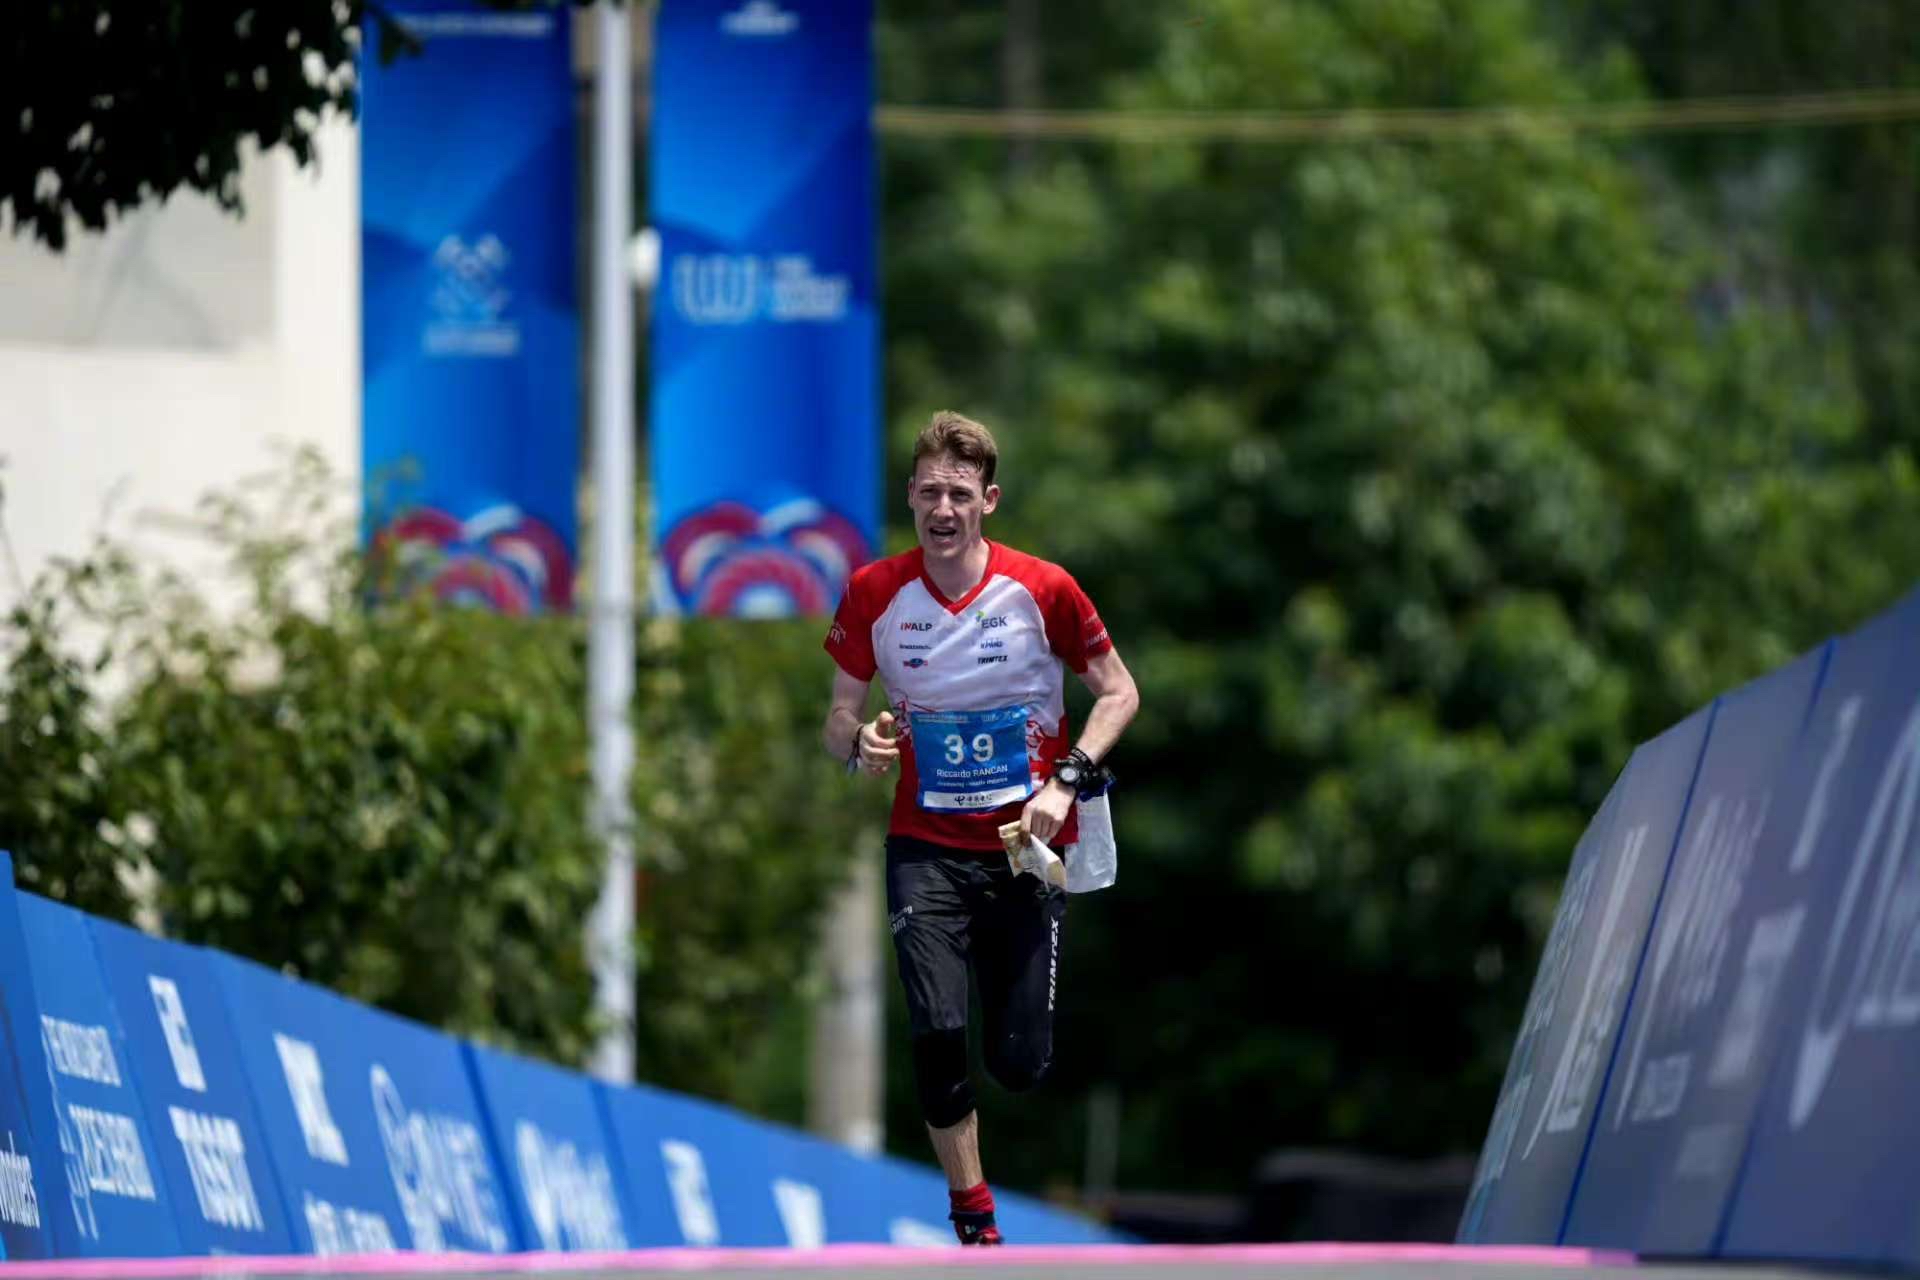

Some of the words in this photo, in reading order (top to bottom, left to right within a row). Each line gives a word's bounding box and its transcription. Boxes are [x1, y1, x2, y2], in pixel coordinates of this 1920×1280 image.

[900, 622, 933, 632] INALP
[981, 615, 1008, 629] EGK
[977, 655, 1008, 664] TRIMTEX
[944, 733, 994, 765] 39
[936, 768, 971, 778] Riccardo
[973, 764, 1008, 777] RANCAN
[1048, 915, 1059, 1012] TRIMTEX
